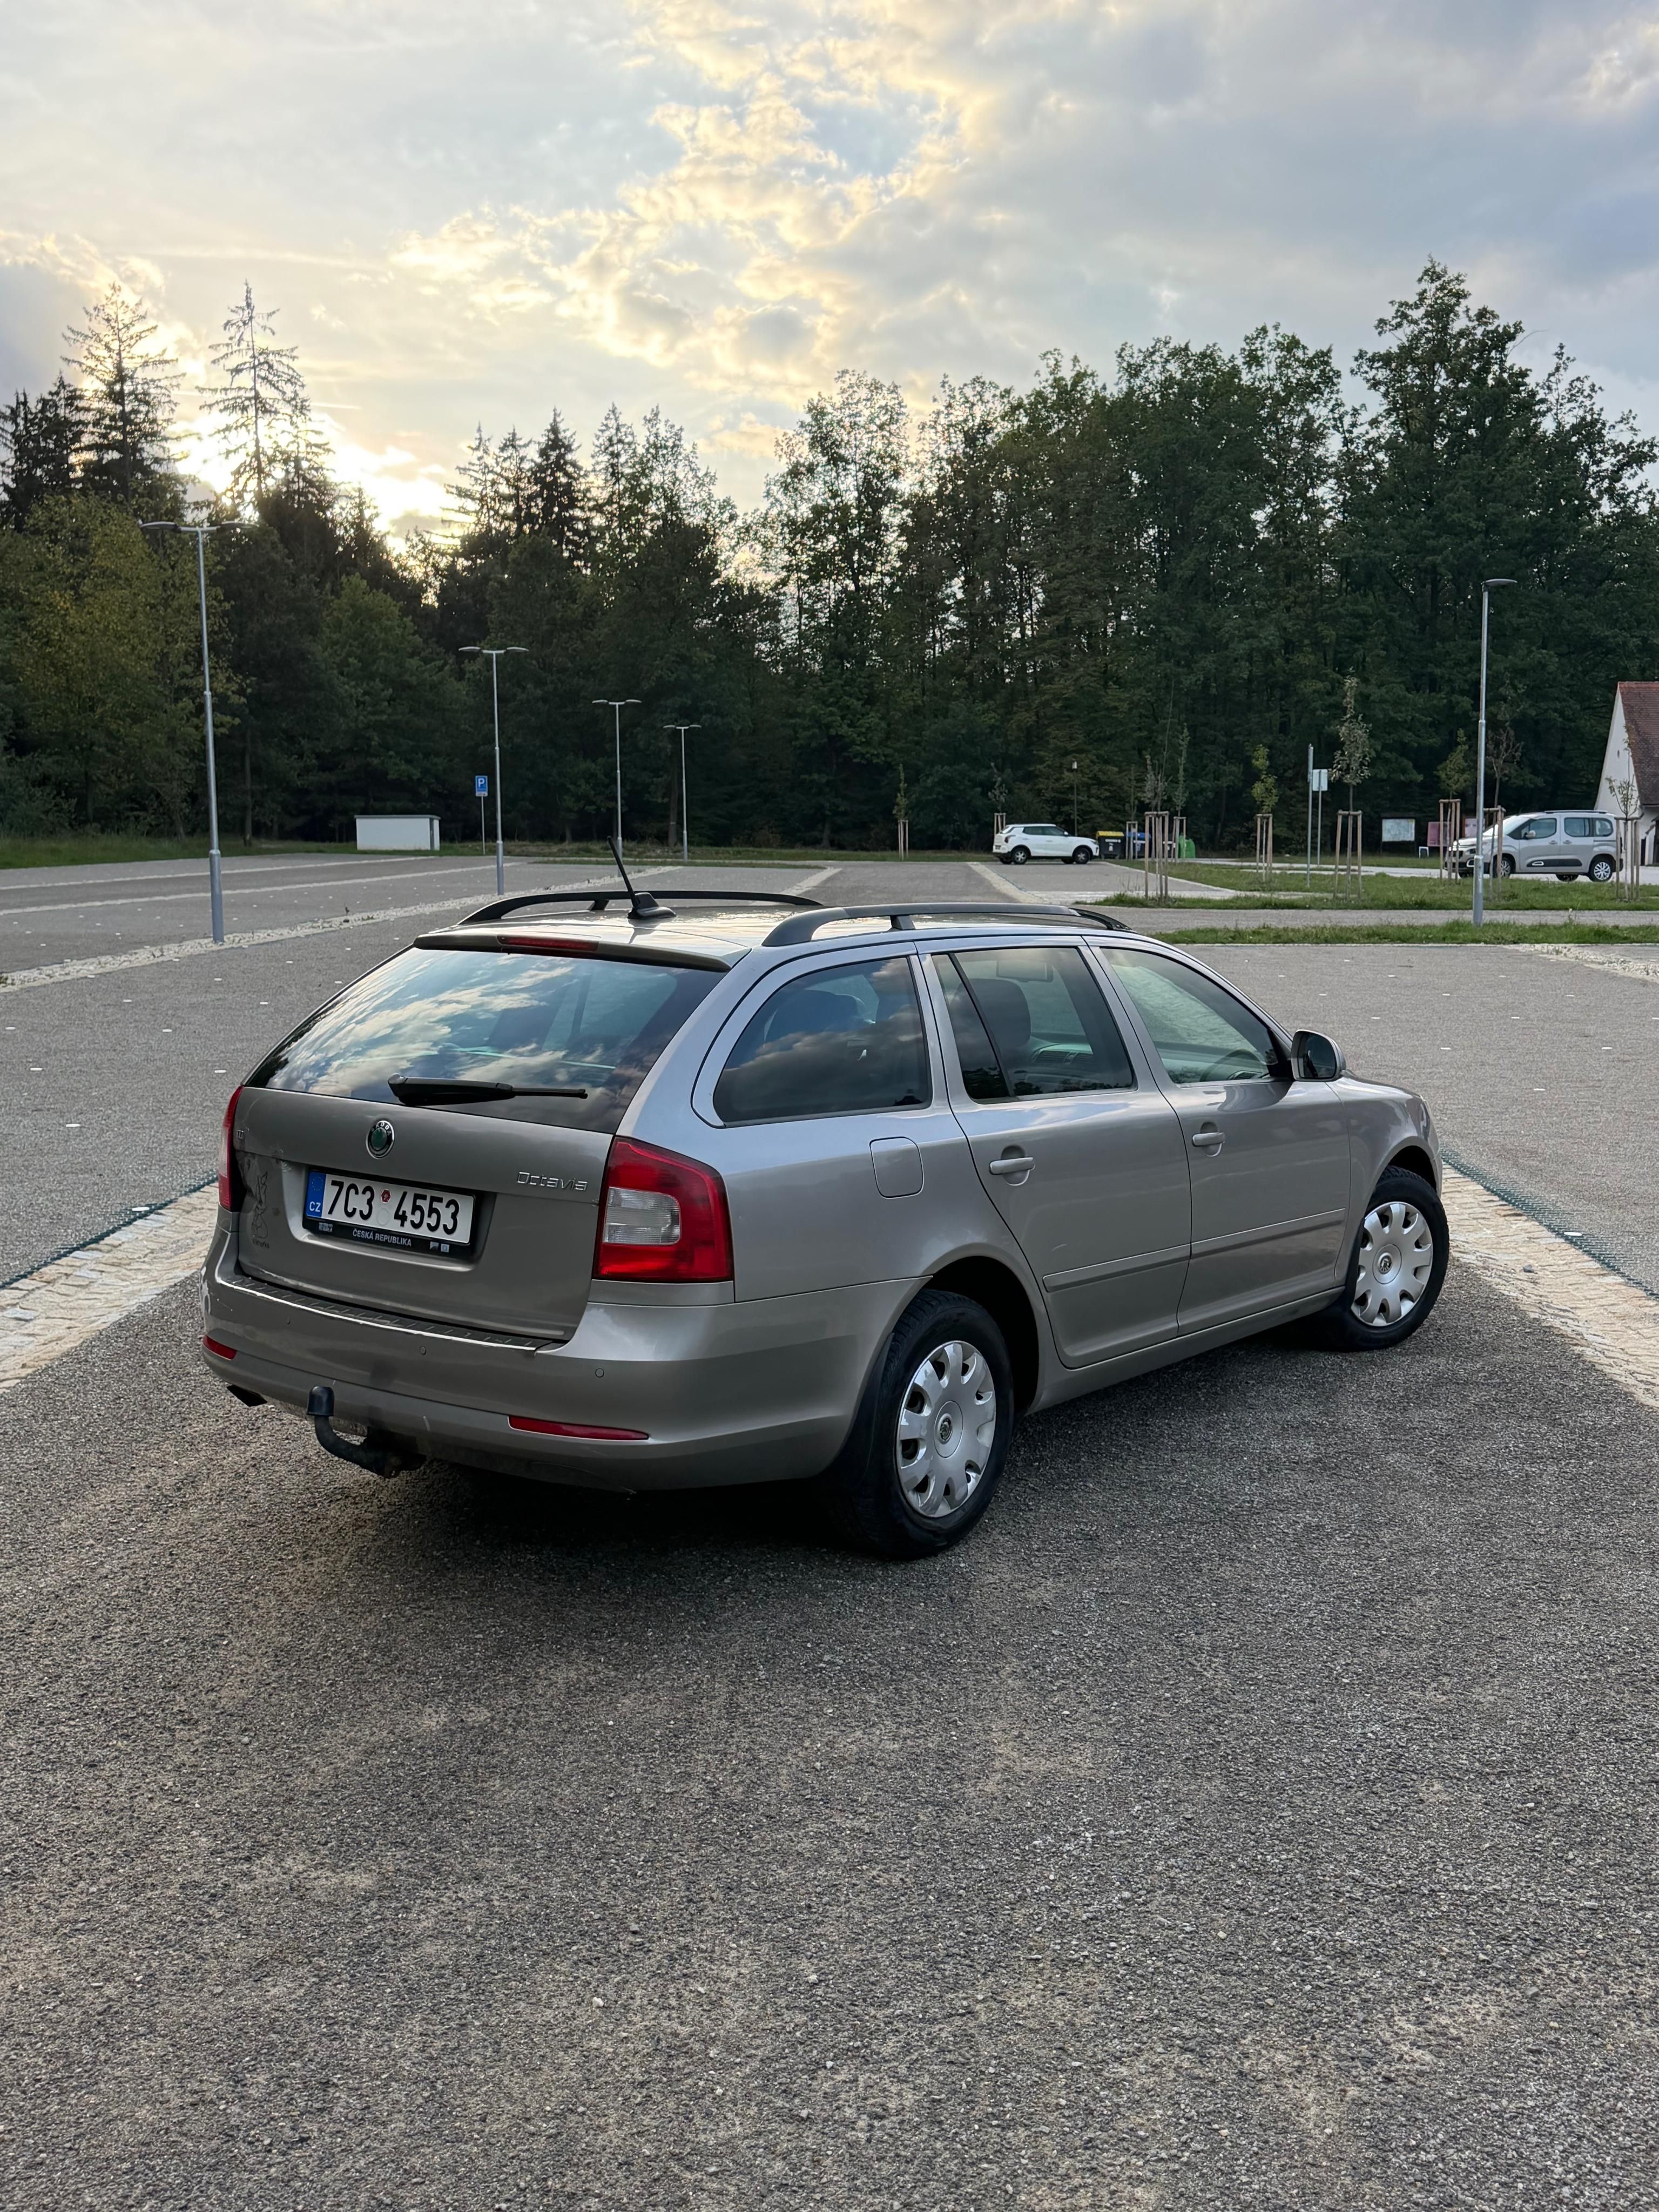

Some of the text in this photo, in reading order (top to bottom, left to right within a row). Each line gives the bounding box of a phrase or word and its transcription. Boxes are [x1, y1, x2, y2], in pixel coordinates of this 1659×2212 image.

[478, 778, 485, 788] P
[517, 1171, 588, 1191] Octavia
[309, 1201, 321, 1213] CZ
[328, 1180, 460, 1235] 7C3 4553
[353, 1228, 412, 1246] ČESKÁ REPUBLIKA
